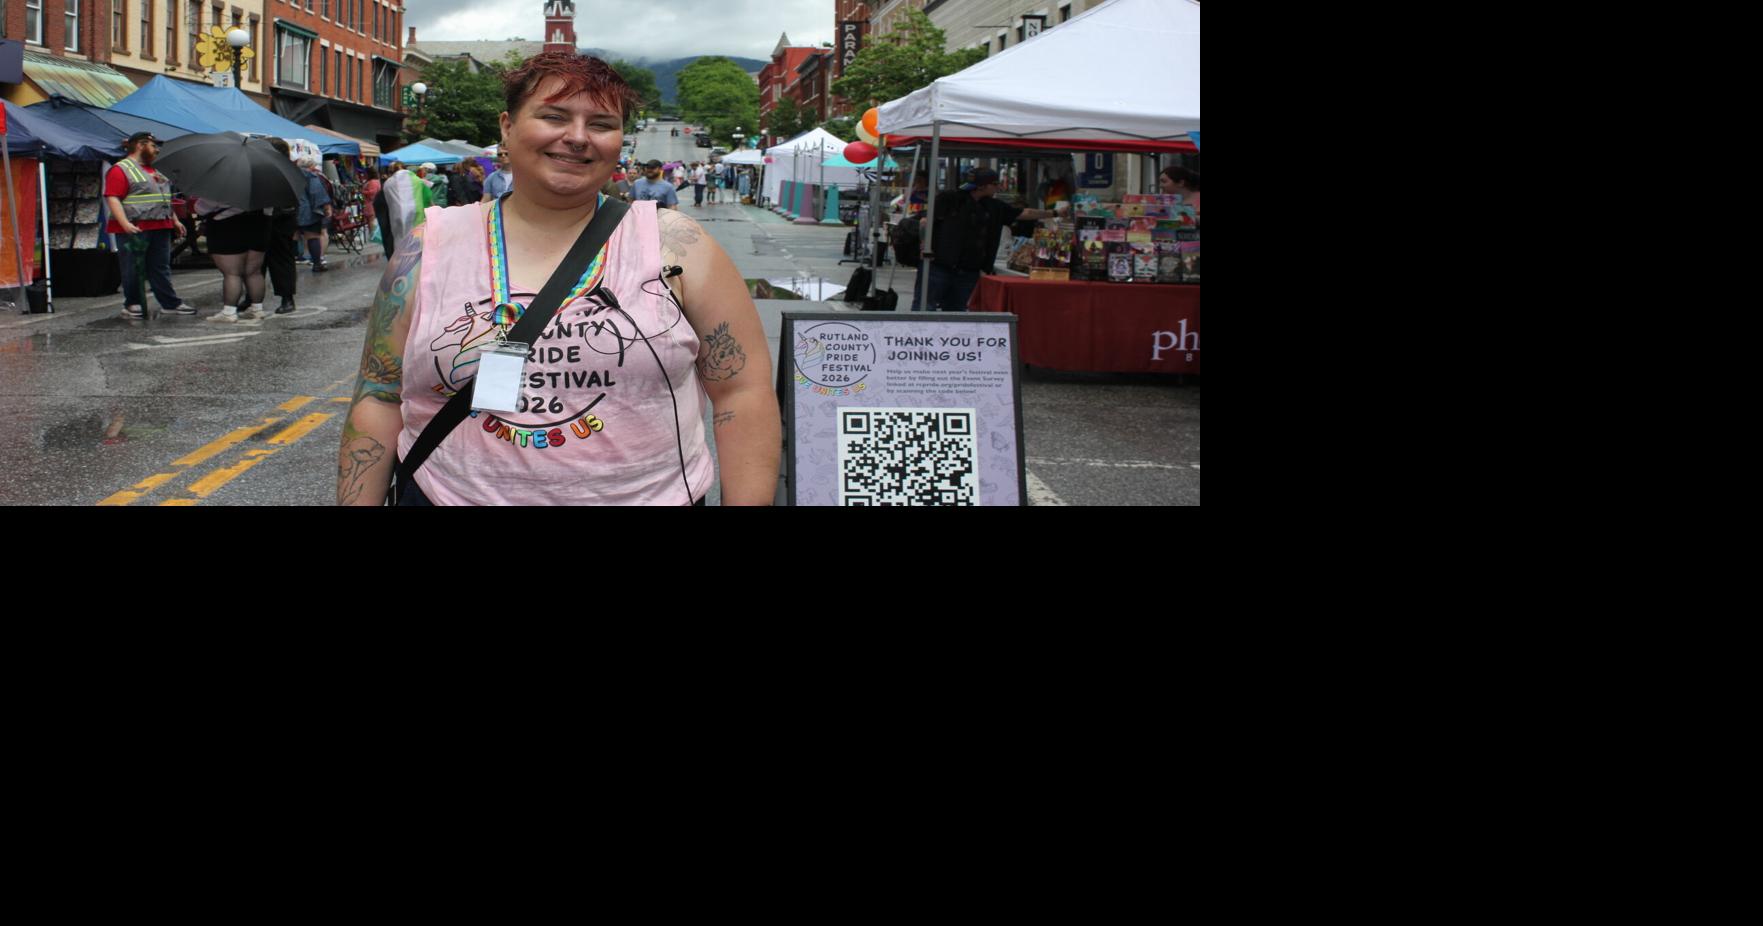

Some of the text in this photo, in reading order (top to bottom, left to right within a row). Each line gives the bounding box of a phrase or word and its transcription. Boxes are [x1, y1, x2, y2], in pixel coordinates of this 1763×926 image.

[820, 333, 869, 341] RUTLAND
[884, 336, 1007, 348] THANK YOU FOR
[825, 343, 870, 351] COUNTY
[527, 345, 581, 364] RIDE
[826, 353, 859, 361] PRIDE
[888, 350, 982, 362] JOINING US!
[821, 364, 872, 372] FESTIVAL
[821, 374, 850, 382] 2026
[812, 384, 850, 397] UNITES
[519, 395, 563, 414] 026
[482, 414, 604, 449] UNITES US
